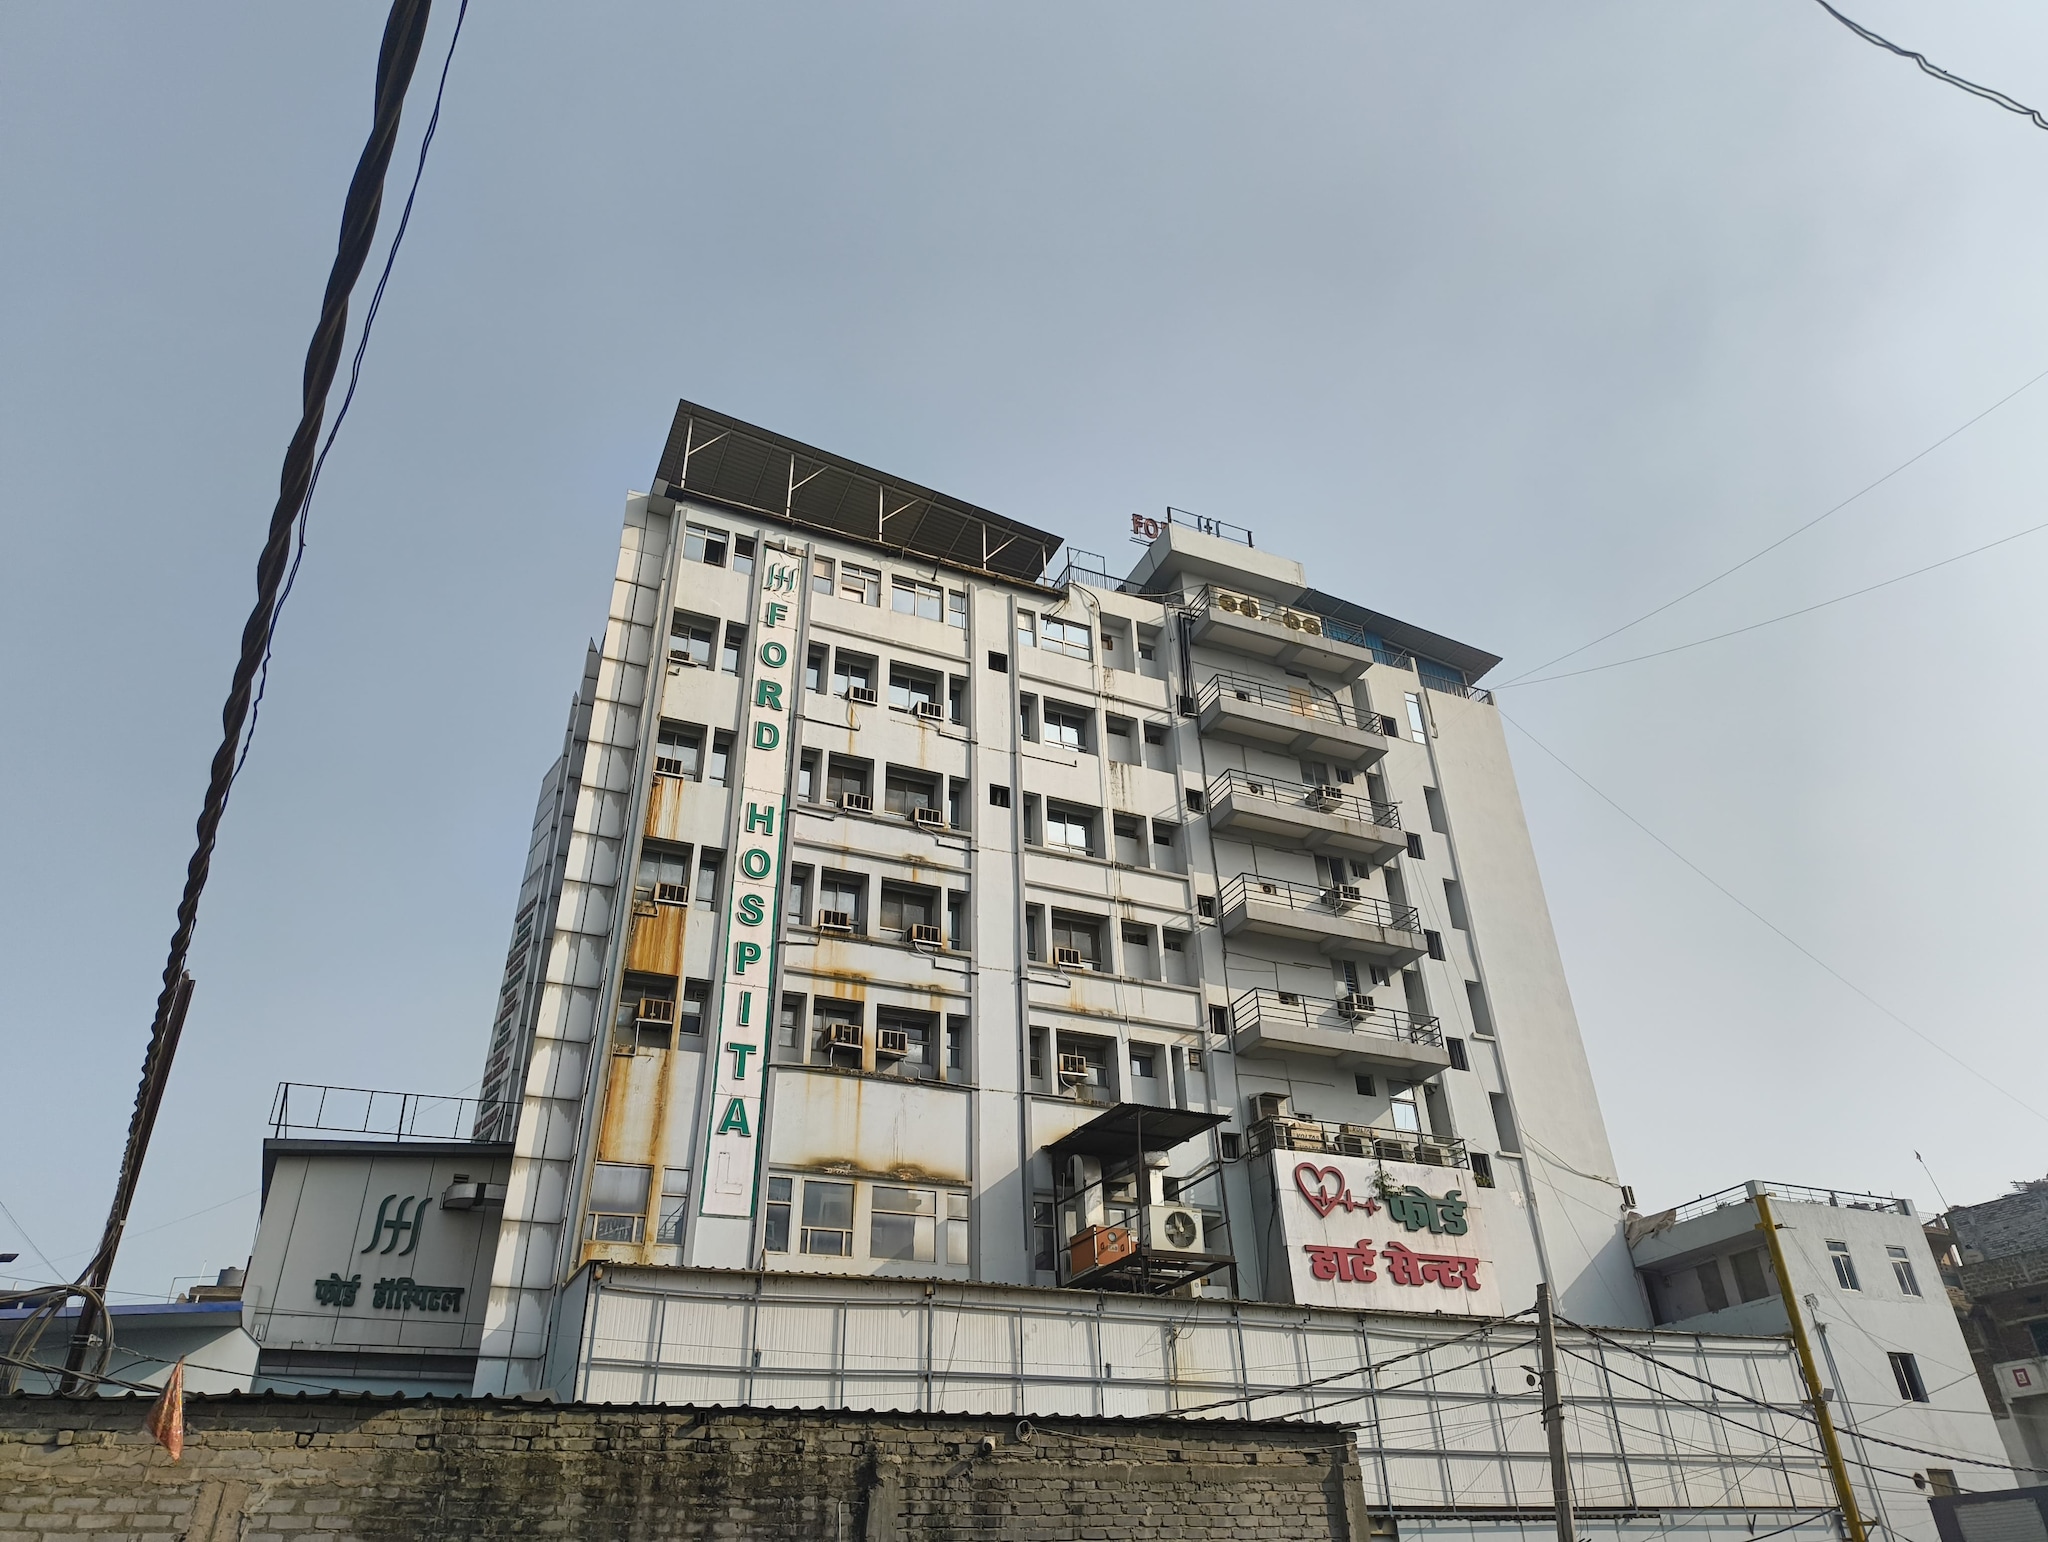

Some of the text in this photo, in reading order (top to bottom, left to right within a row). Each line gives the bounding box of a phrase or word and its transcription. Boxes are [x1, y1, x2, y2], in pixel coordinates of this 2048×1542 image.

[754, 601, 788, 751] FORD
[1386, 1185, 1468, 1236] फोर्ड
[1304, 1238, 1482, 1291] हार्ट सेन्टर
[314, 1272, 465, 1313] फोर्ड हॉस्पिटल
